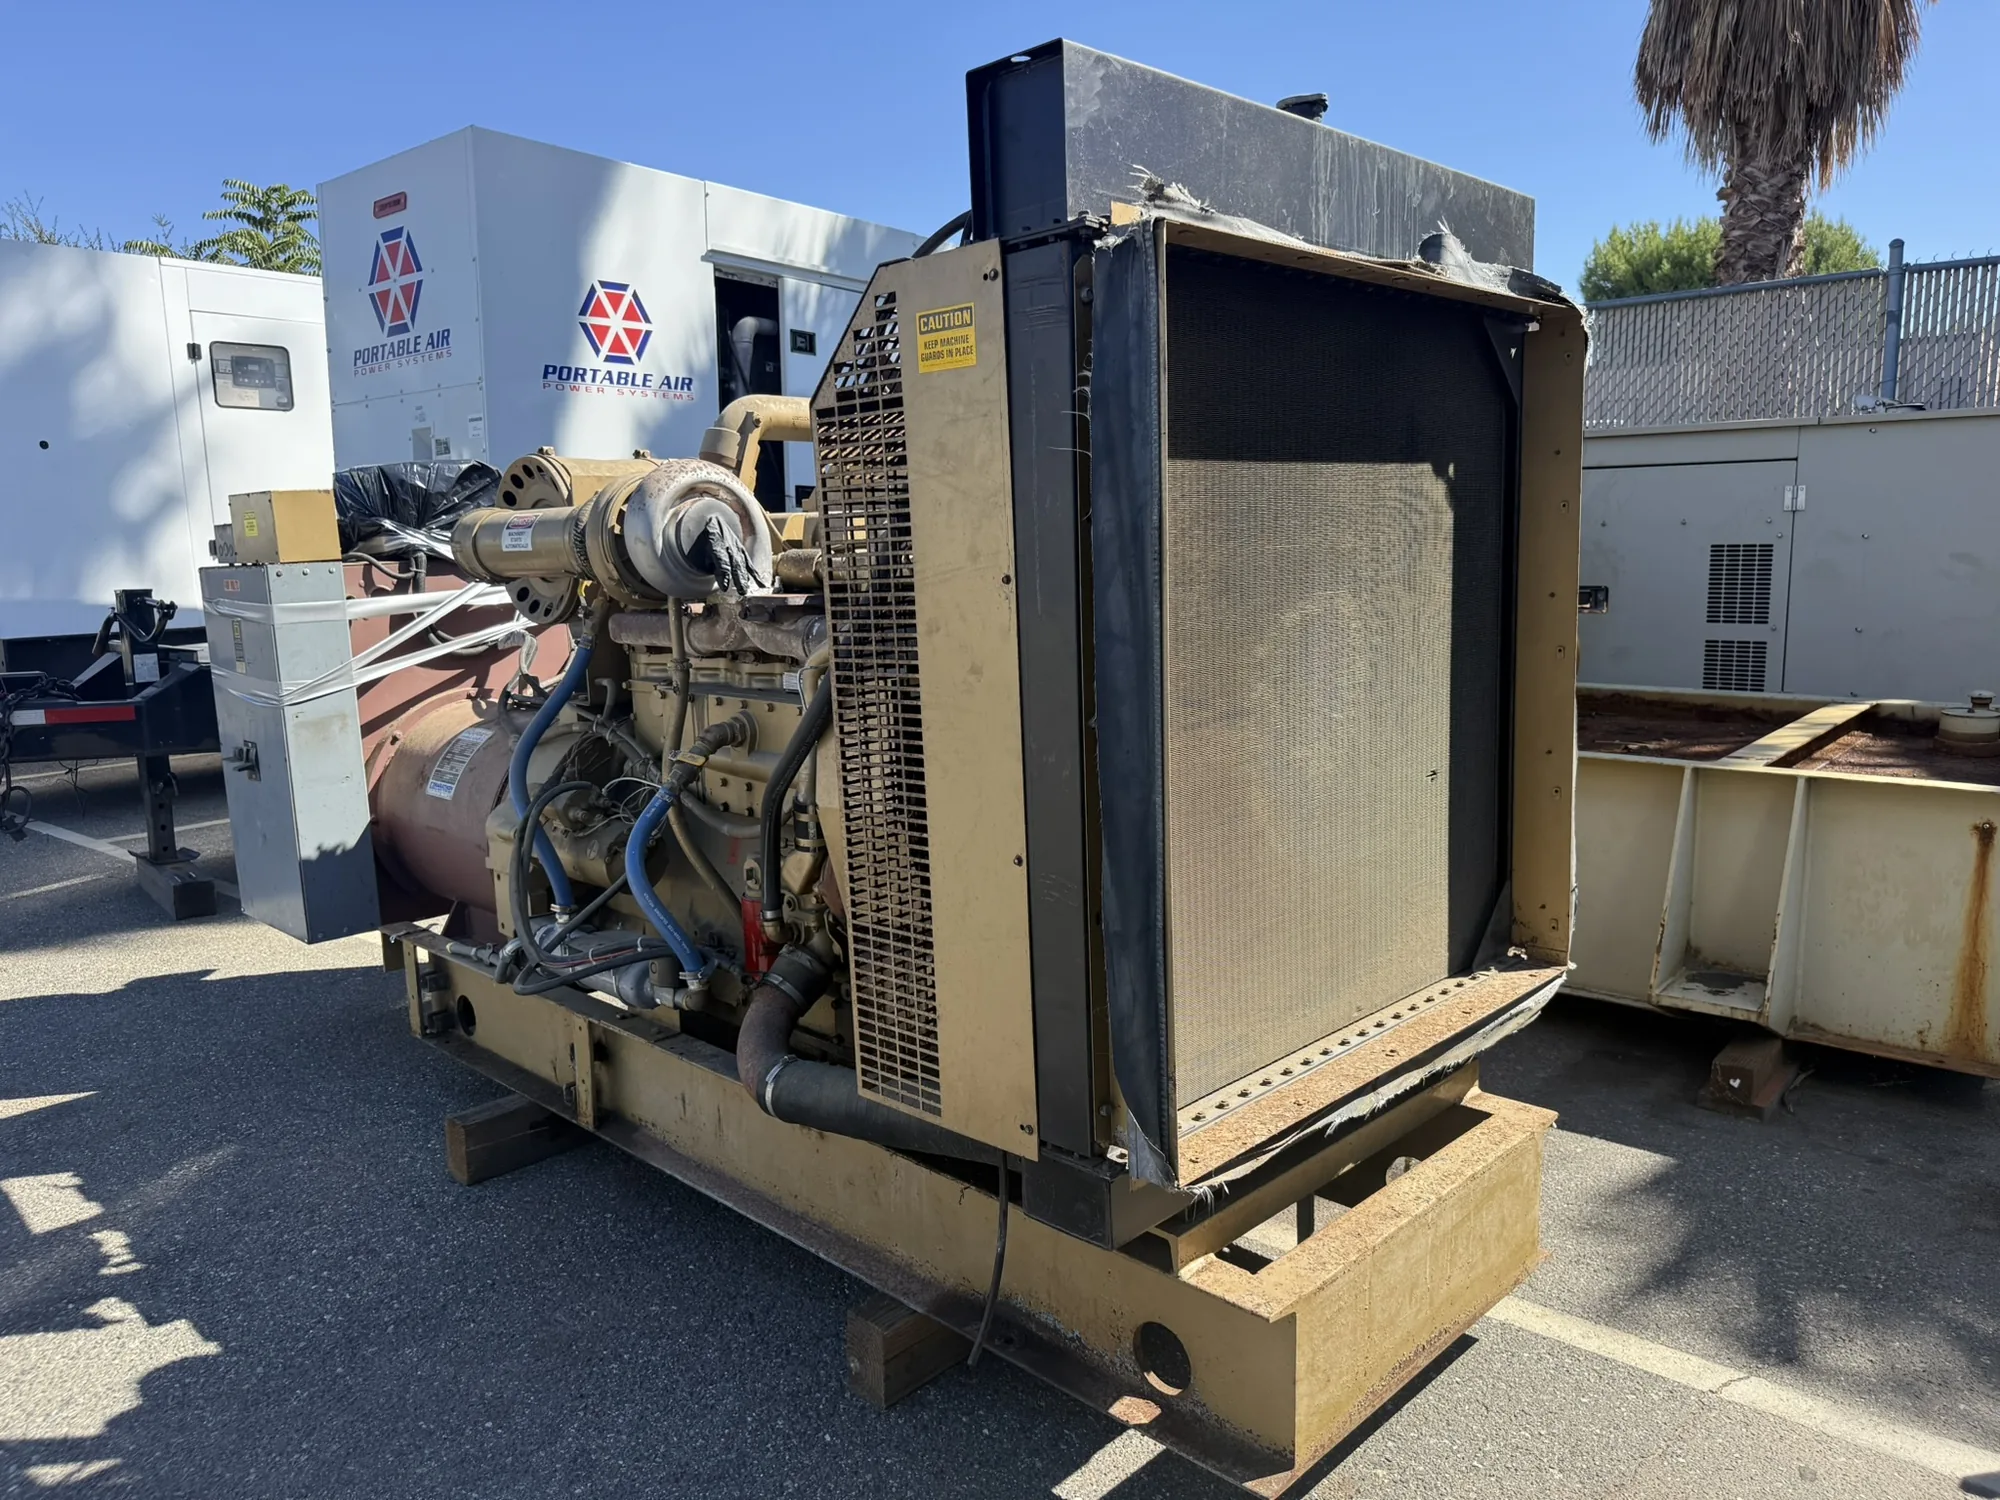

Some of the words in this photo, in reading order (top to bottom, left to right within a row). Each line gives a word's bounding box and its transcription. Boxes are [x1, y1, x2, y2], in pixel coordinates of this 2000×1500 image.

[919, 309, 971, 332] CAUTION
[354, 335, 421, 366] PORTABLE
[425, 328, 450, 351] AIR
[924, 339, 938, 350] KEEP
[940, 334, 969, 347] MACHINE
[354, 364, 391, 377] POWER
[398, 350, 452, 367] SYSTEMS
[921, 350, 945, 362] GUARDS
[946, 349, 953, 358] IN
[955, 346, 974, 357] PLACE
[542, 364, 653, 388] PORTABLE
[659, 375, 693, 391] AIR
[542, 383, 605, 394] POWER
[617, 388, 694, 401] SYSTEMS
